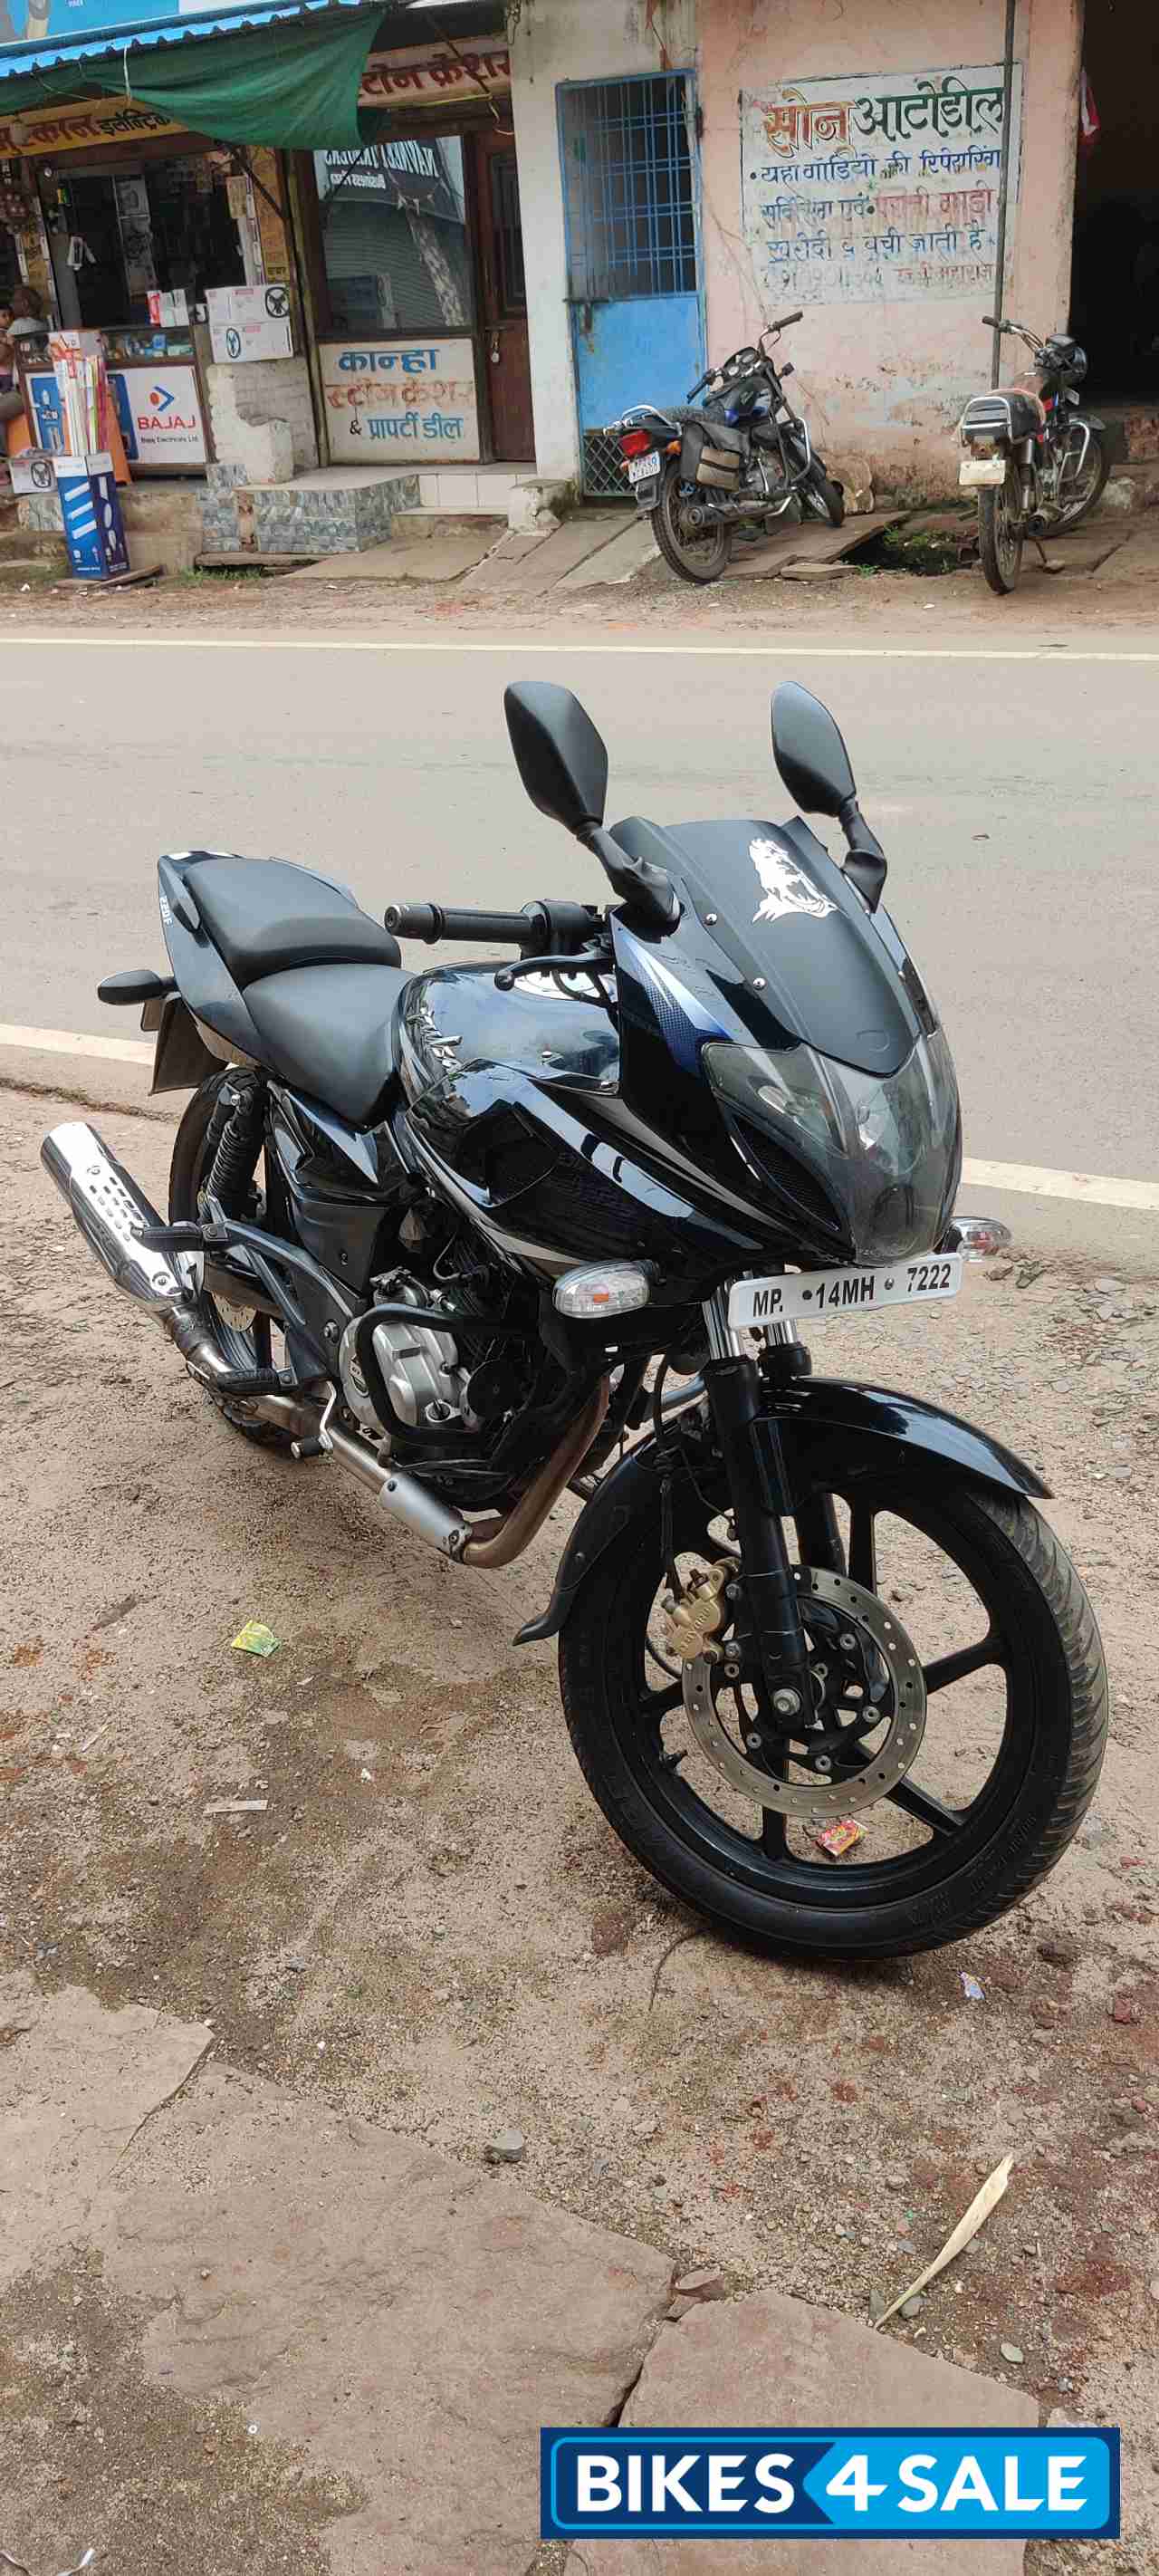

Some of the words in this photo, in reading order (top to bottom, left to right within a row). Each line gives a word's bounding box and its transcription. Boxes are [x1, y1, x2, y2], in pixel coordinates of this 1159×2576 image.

[339, 348, 440, 373] कान्हा
[137, 415, 196, 430] BAJAJ
[350, 419, 362, 435] &
[815, 1274, 875, 1309] 14MH
[907, 1263, 951, 1292] 7222
